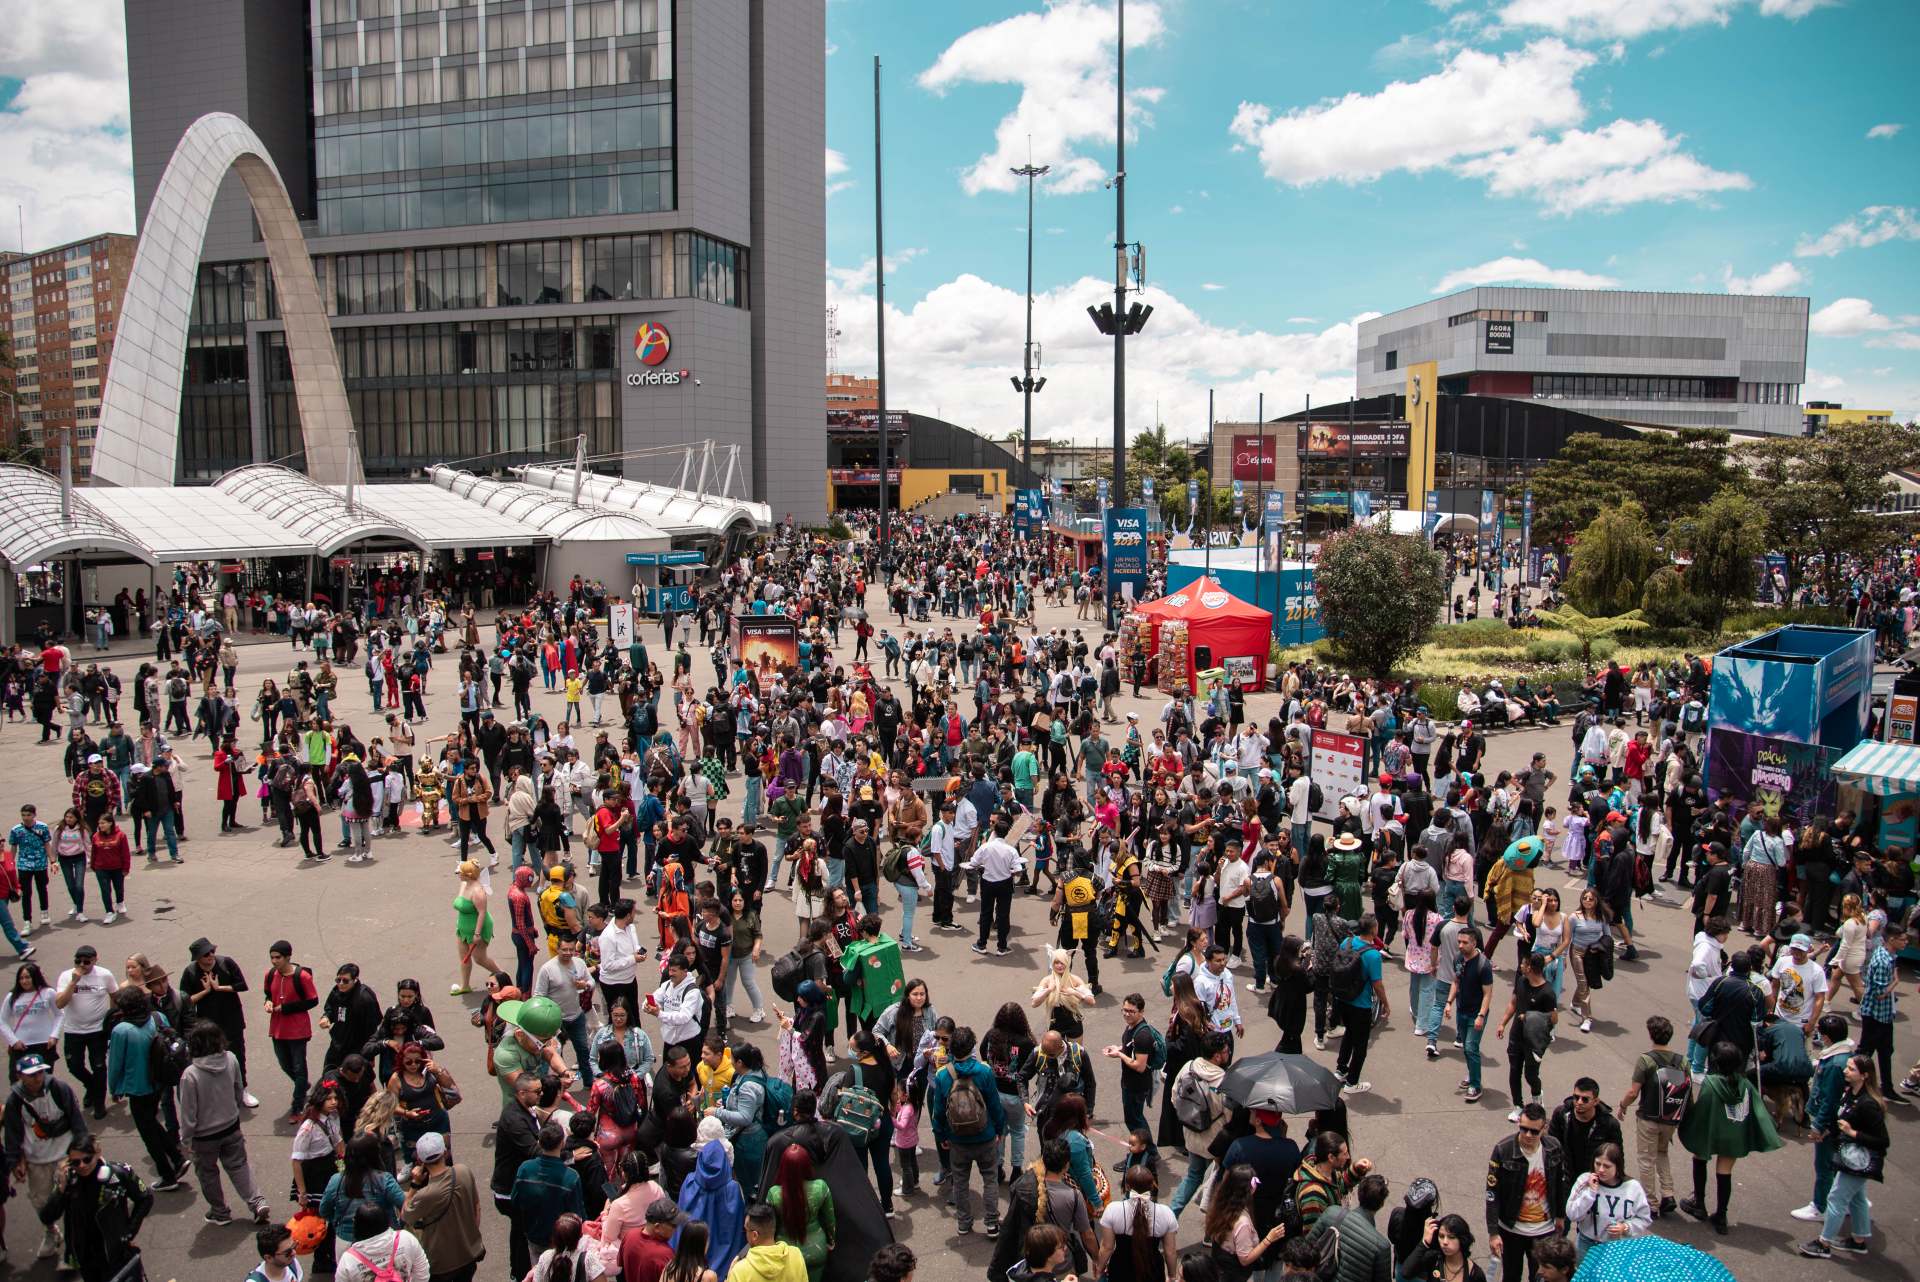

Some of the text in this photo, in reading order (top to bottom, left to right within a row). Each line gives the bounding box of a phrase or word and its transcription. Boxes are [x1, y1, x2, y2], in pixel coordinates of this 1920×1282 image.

[627, 369, 680, 385] corferias
[1412, 374, 1421, 406] 3
[1116, 519, 1139, 528] VISA
[1113, 531, 1142, 540] SOFA
[1114, 539, 1140, 547] 2024
[1285, 596, 1320, 610] SOFA
[1892, 723, 1912, 731] GUD
